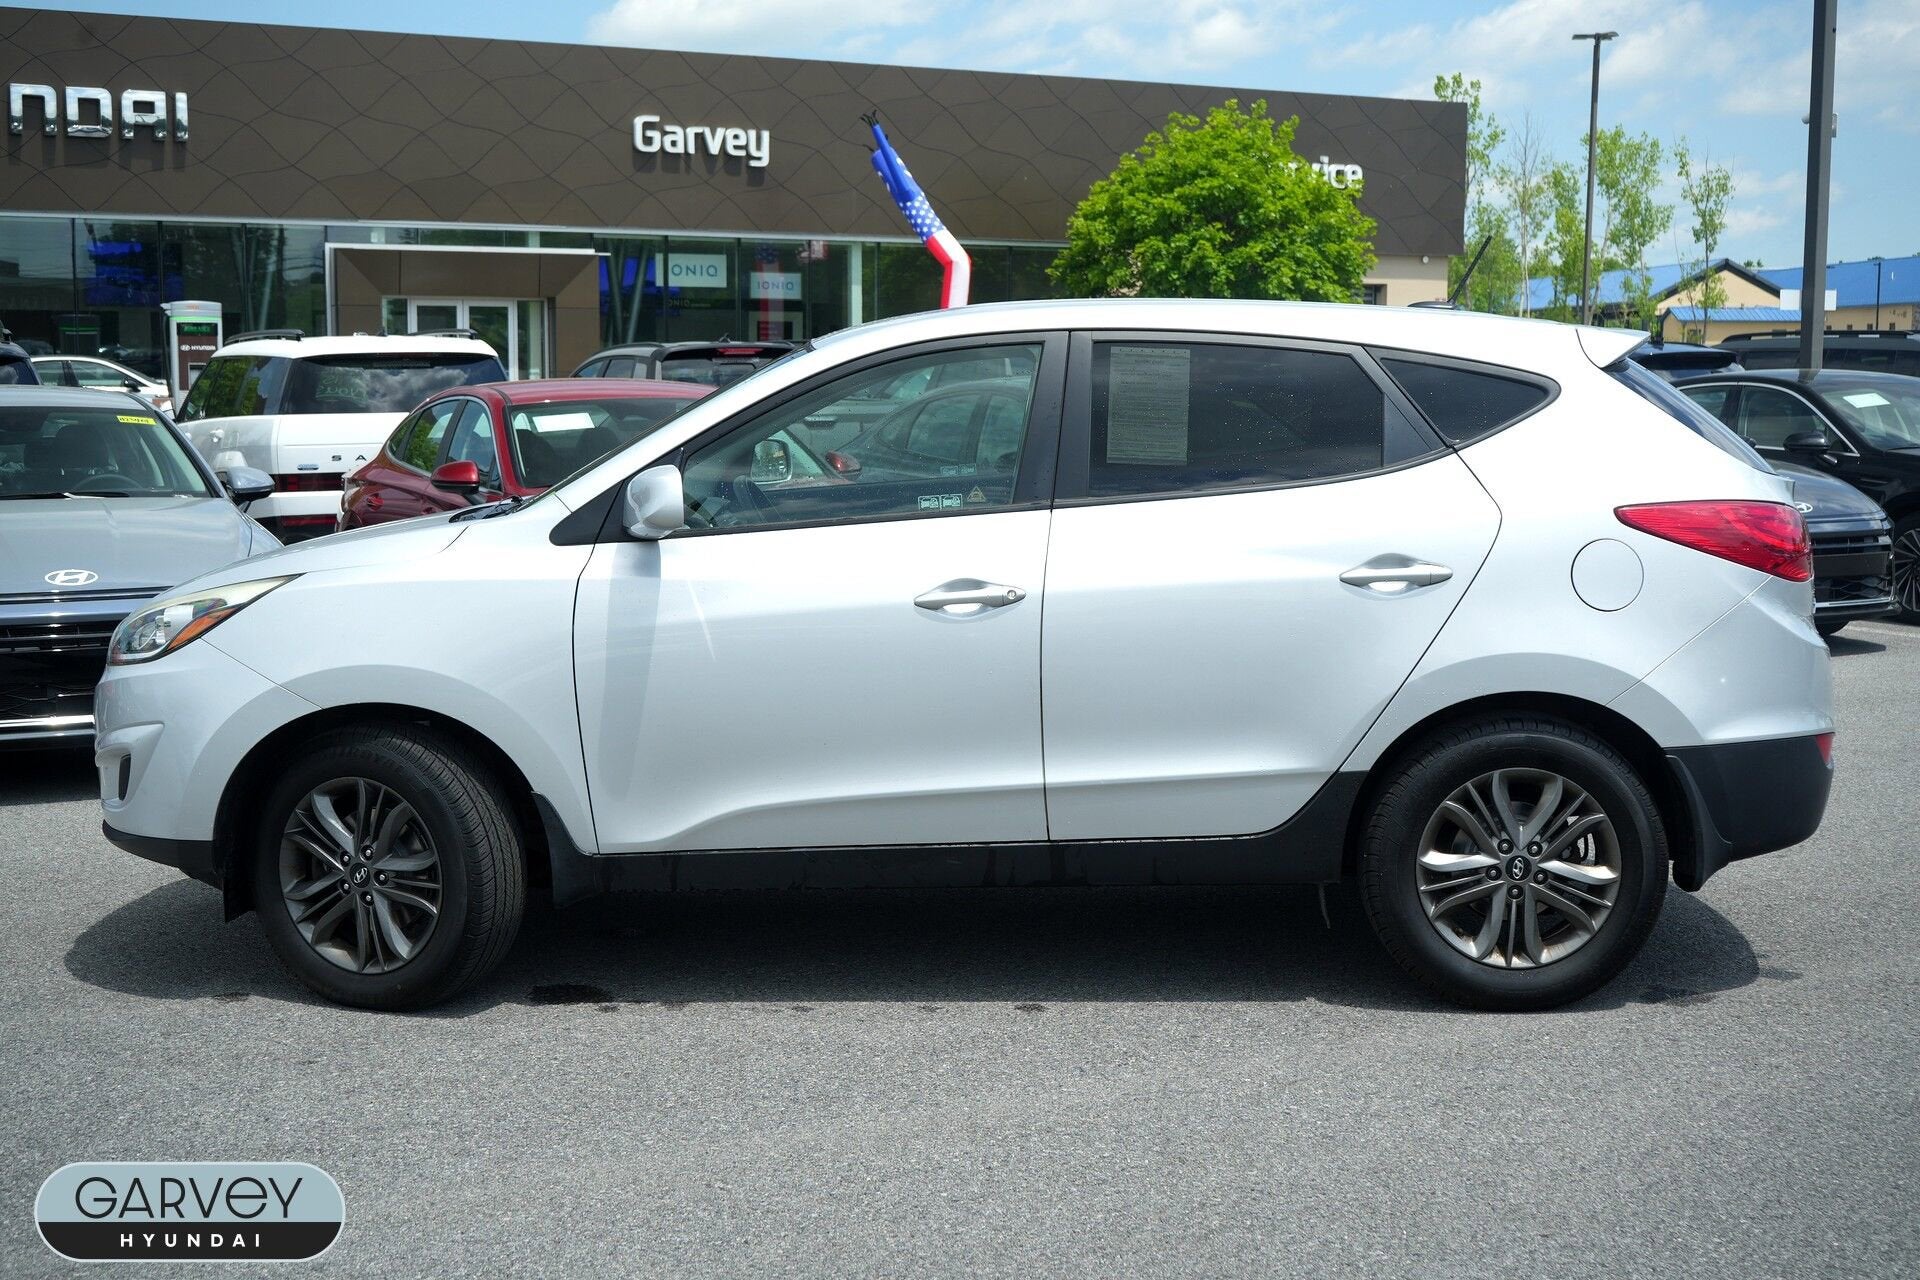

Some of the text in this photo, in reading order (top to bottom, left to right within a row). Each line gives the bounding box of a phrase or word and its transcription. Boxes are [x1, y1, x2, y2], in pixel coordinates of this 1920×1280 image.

[633, 114, 770, 167] Garvey
[671, 263, 718, 277] ONIQ
[757, 281, 794, 291] IONIQ
